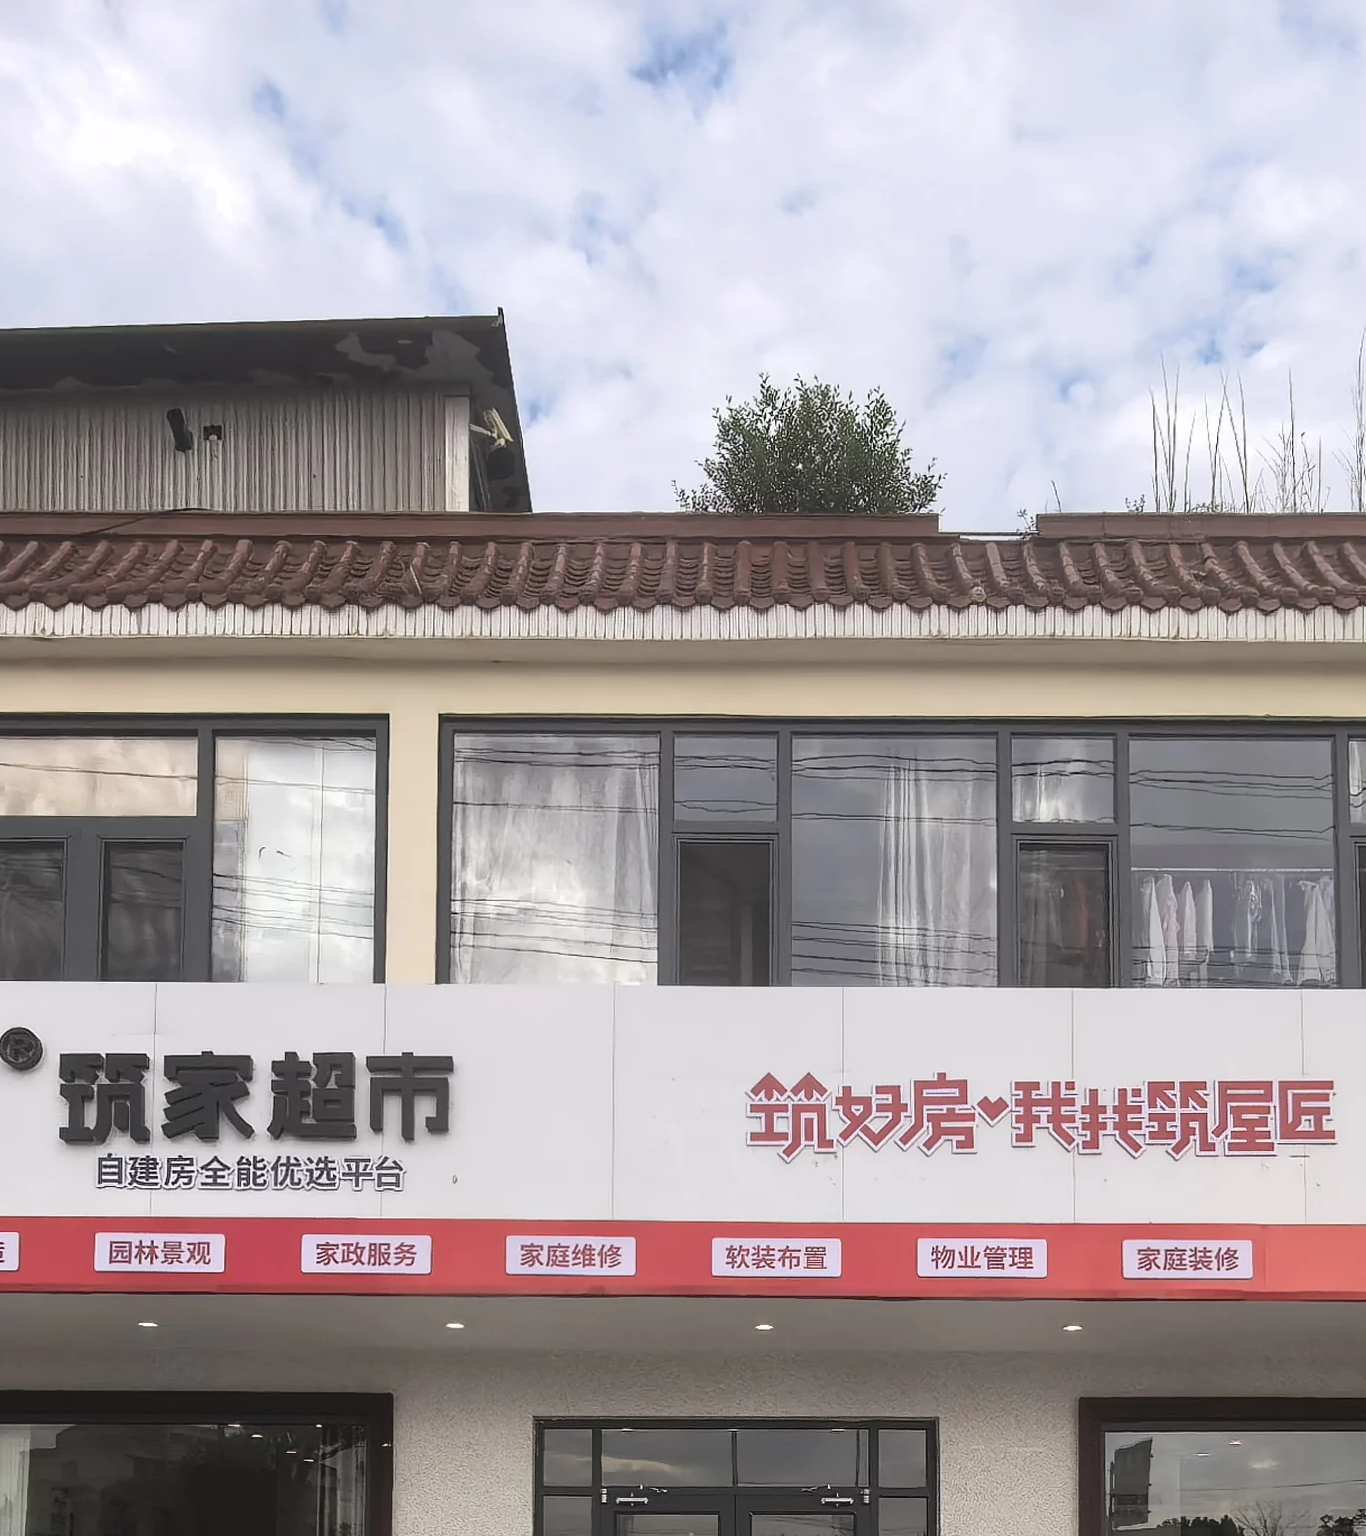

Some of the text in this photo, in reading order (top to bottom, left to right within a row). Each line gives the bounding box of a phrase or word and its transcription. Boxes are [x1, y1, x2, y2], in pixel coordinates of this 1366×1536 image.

[58, 1050, 454, 1144] 筑家超市
[746, 1071, 1337, 1163] 筑好房 我找筑屋匠
[95, 1154, 406, 1190] 自建房全能优选平台
[109, 1240, 211, 1265] 园林景观
[316, 1242, 417, 1266] 家政服务
[520, 1243, 622, 1268] 家庭维修
[725, 1245, 827, 1269] 软装布置
[931, 1245, 1033, 1270] 物业管理
[1137, 1247, 1239, 1271] 家庭装修
